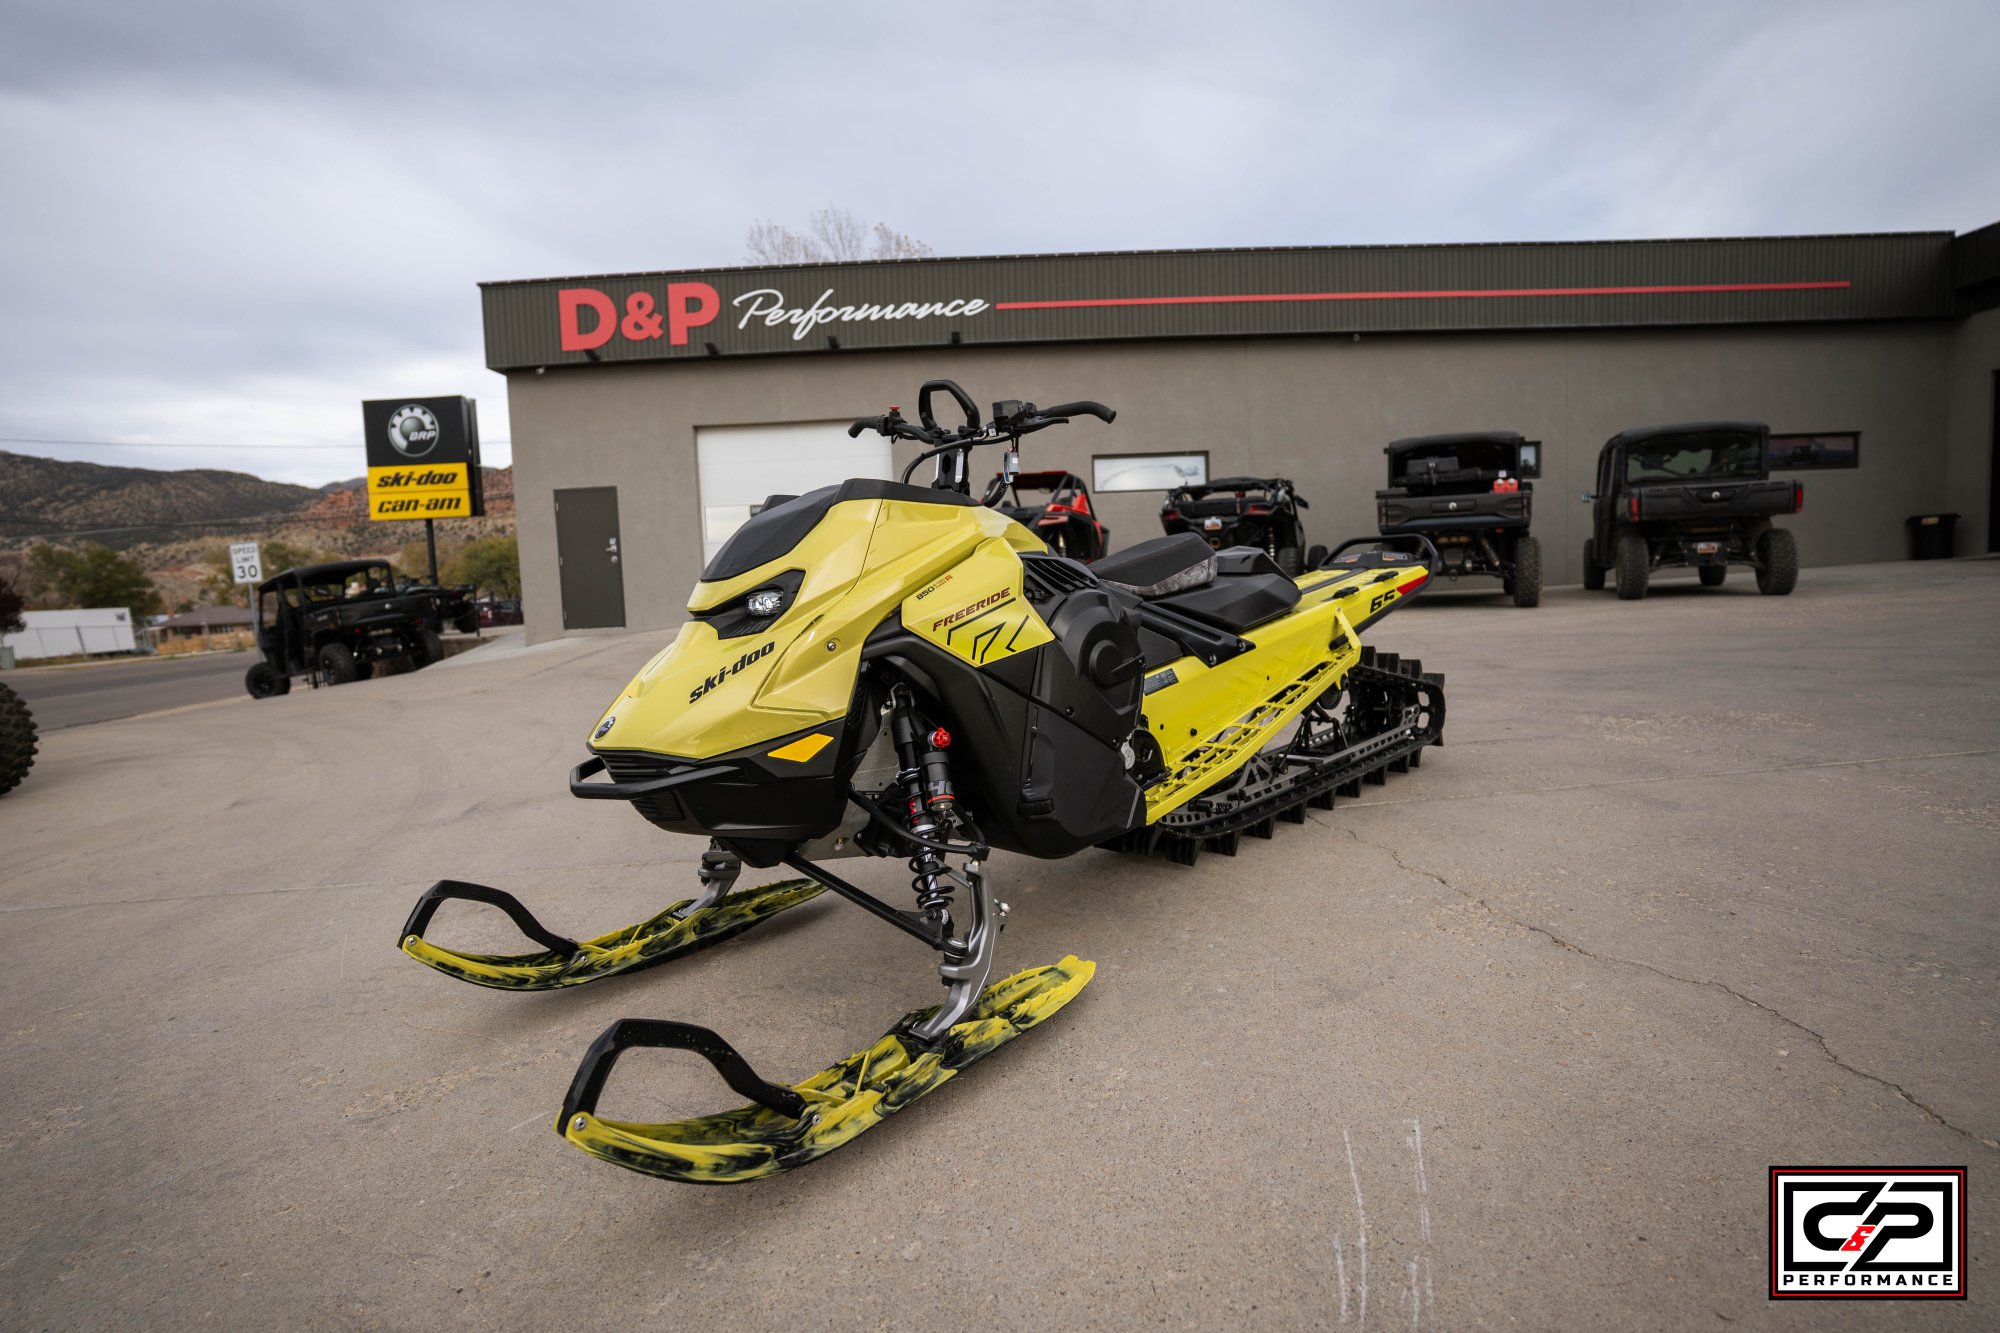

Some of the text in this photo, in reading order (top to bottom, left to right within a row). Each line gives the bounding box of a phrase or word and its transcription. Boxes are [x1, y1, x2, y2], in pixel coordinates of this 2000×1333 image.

[558, 282, 990, 352] D&P Performance
[408, 430, 437, 442] BRP
[376, 470, 458, 488] ski-doo
[377, 497, 462, 514] can-am
[231, 545, 256, 555] SPEED
[235, 554, 255, 563] LIMIT
[237, 564, 258, 579] 30
[916, 586, 935, 600] 850
[932, 586, 1011, 633] FREERIDE
[689, 641, 775, 705] ski-doo
